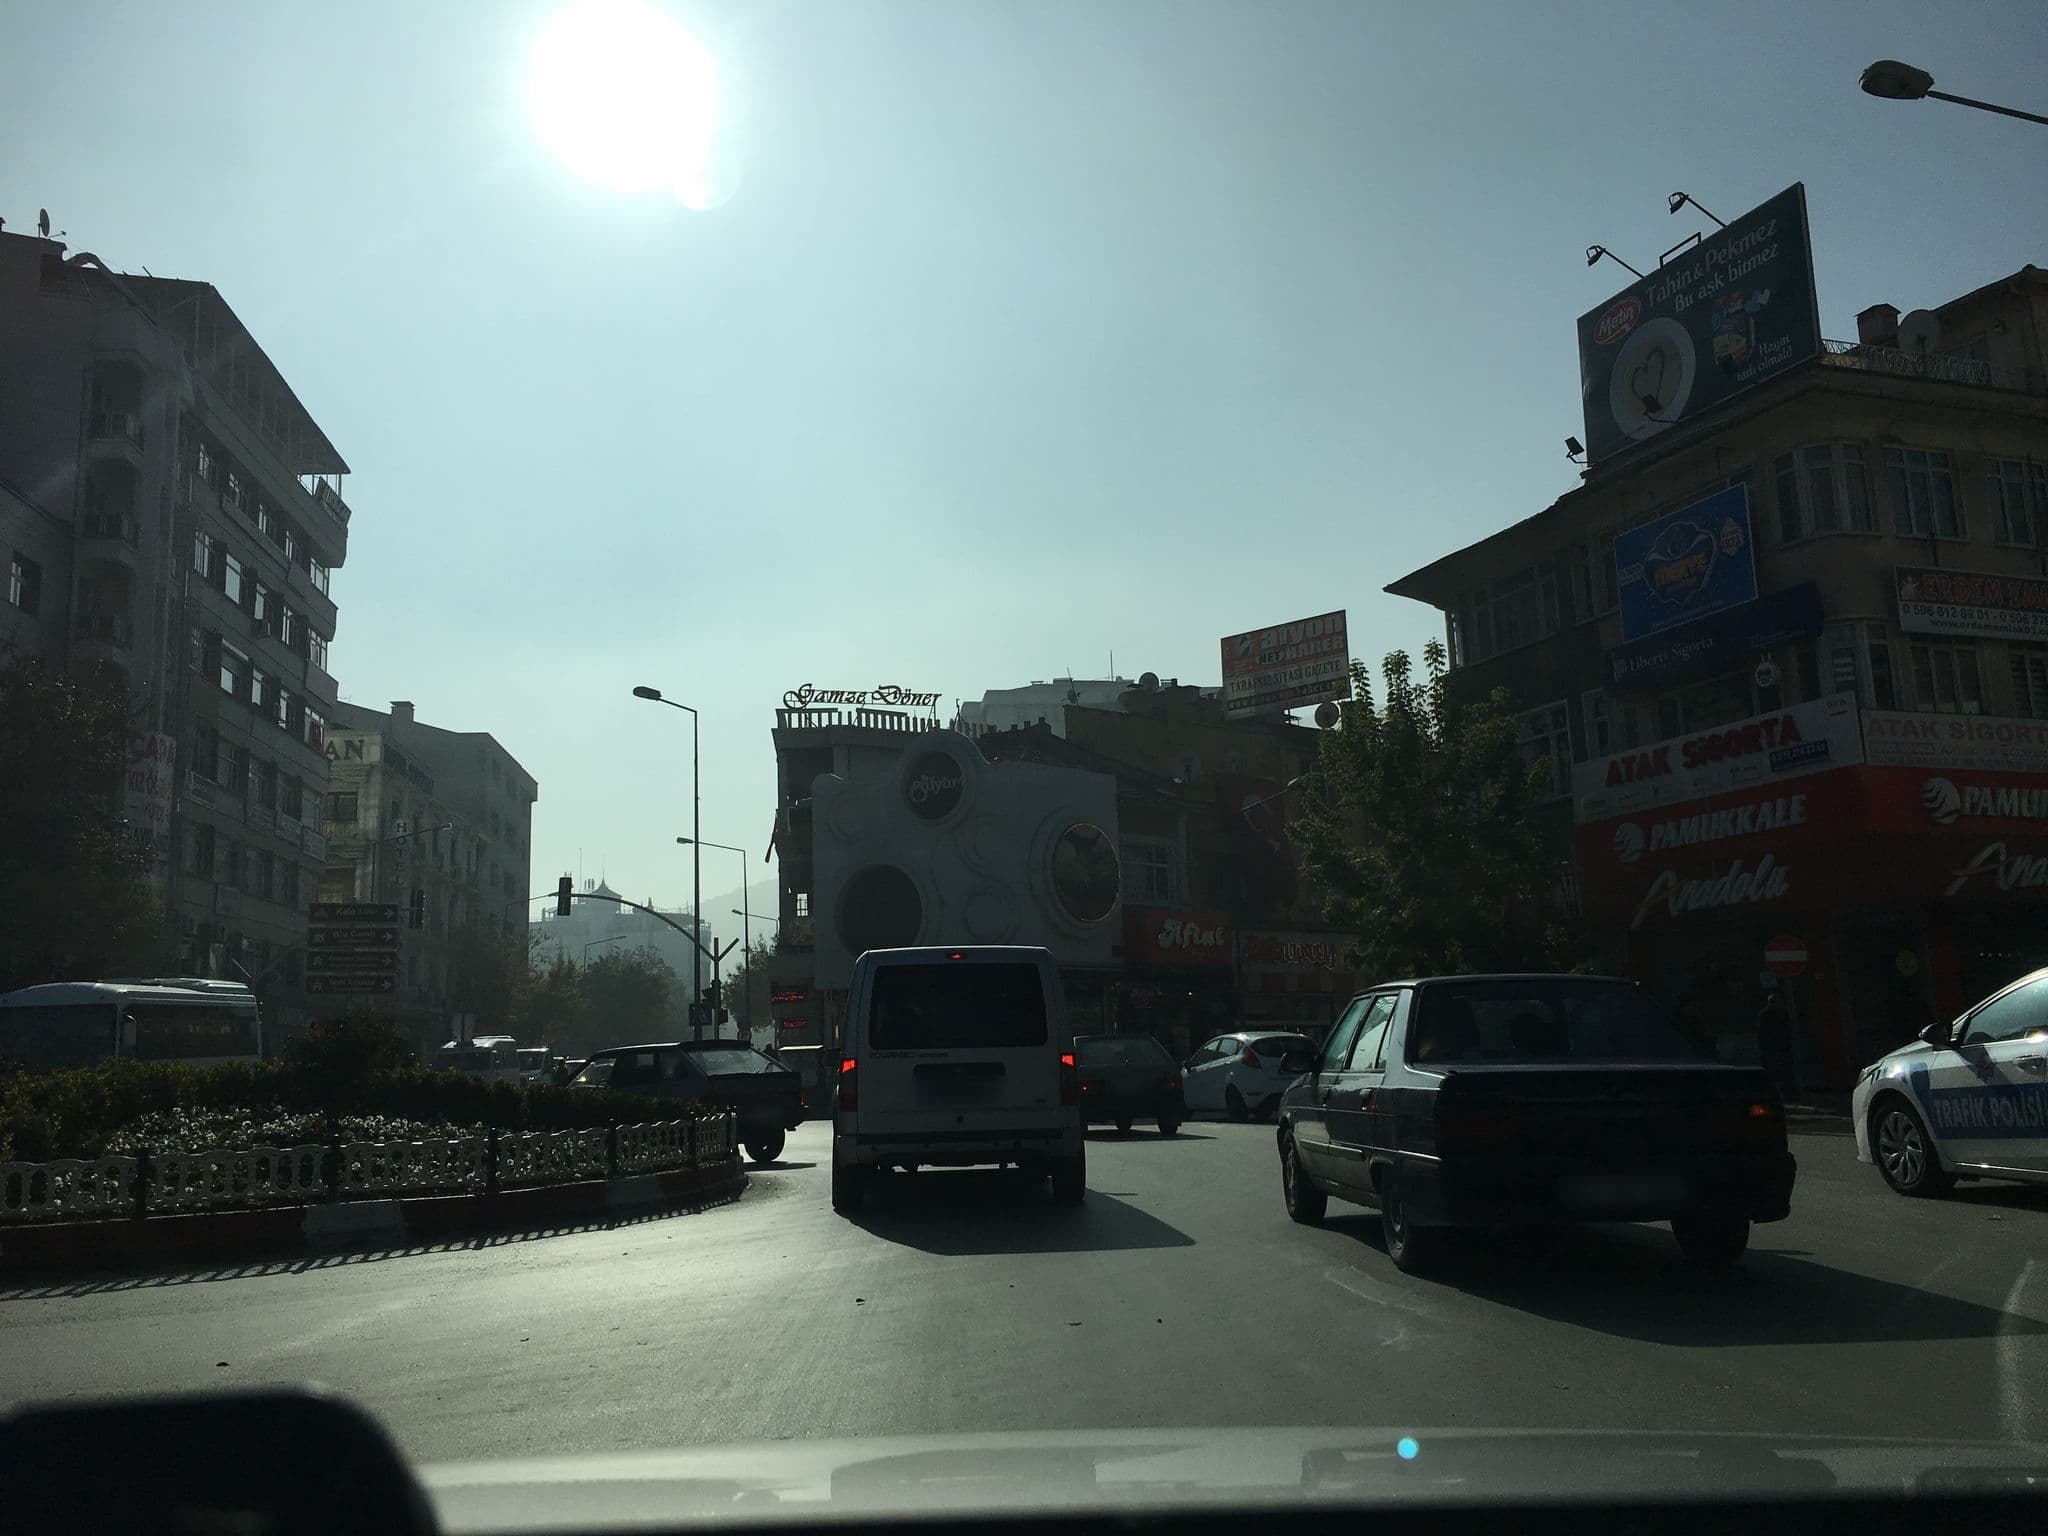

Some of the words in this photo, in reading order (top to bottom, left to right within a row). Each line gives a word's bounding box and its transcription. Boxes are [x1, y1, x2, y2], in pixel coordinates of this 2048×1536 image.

[1647, 269, 1692, 308] Tahin
[1705, 219, 1777, 272] Pekmez
[1674, 292, 1694, 313] Bu
[1728, 244, 1778, 282] bitmez
[1304, 659, 1341, 678] GAZETE
[783, 683, 868, 709] Gamze
[871, 685, 942, 706] Döner
[1866, 719, 1937, 739] ATAK
[1605, 746, 1673, 787] ATAK
[1650, 793, 1808, 852] PAMUKKALE
[1933, 1091, 1986, 1129] TRAFİK
